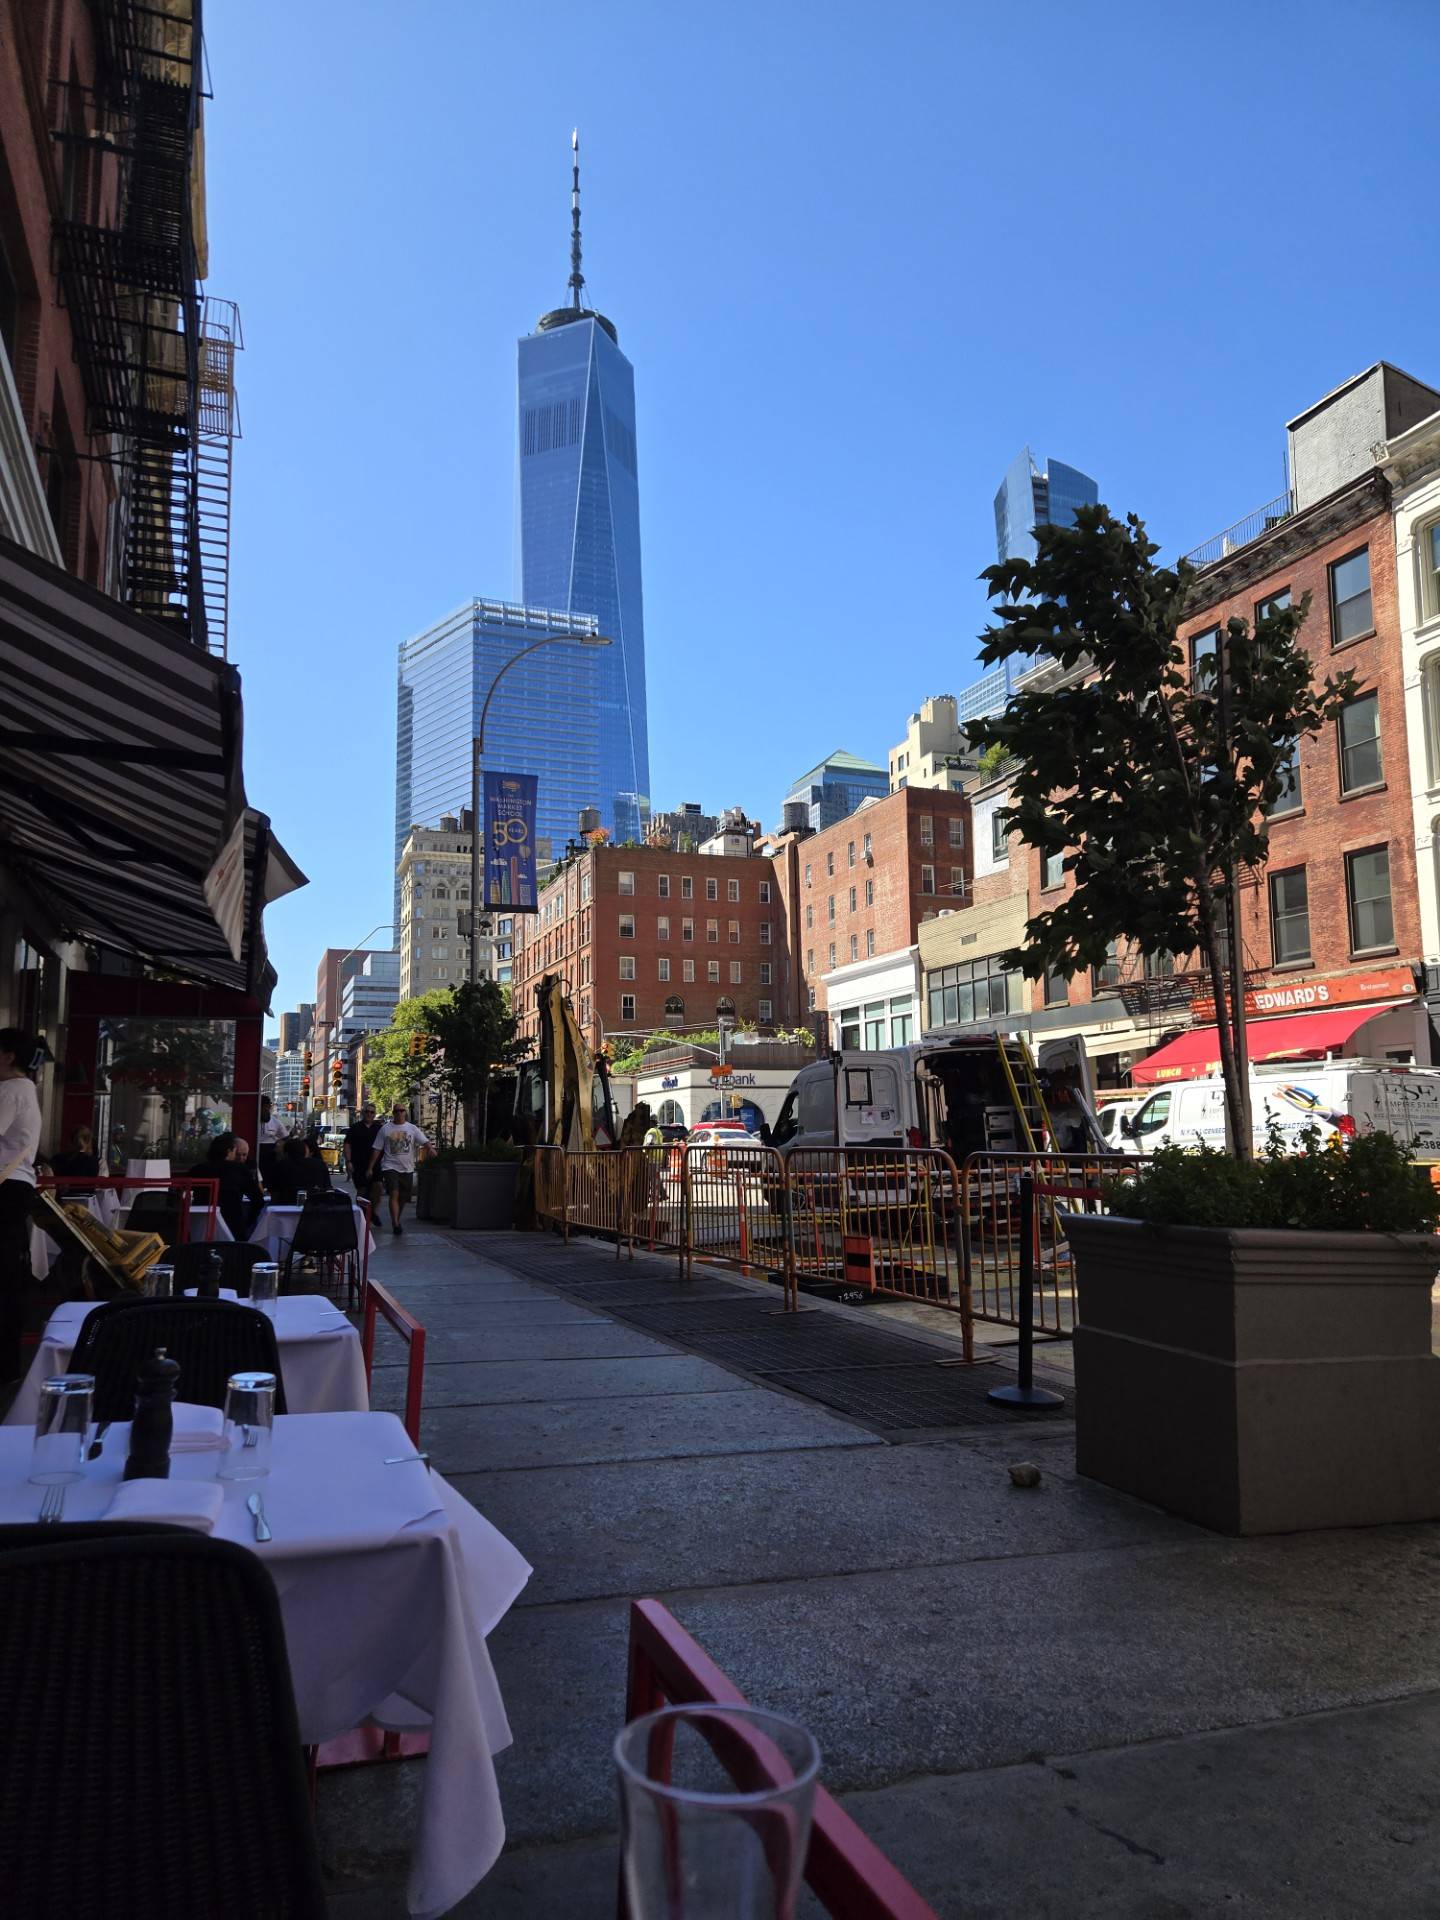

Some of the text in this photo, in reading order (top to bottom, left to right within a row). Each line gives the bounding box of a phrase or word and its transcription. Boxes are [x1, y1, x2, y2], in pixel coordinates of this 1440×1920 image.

[493, 819, 528, 846] 50
[1255, 985, 1330, 1010] EDWARD'S
[1156, 1067, 1182, 1079] LUNCH
